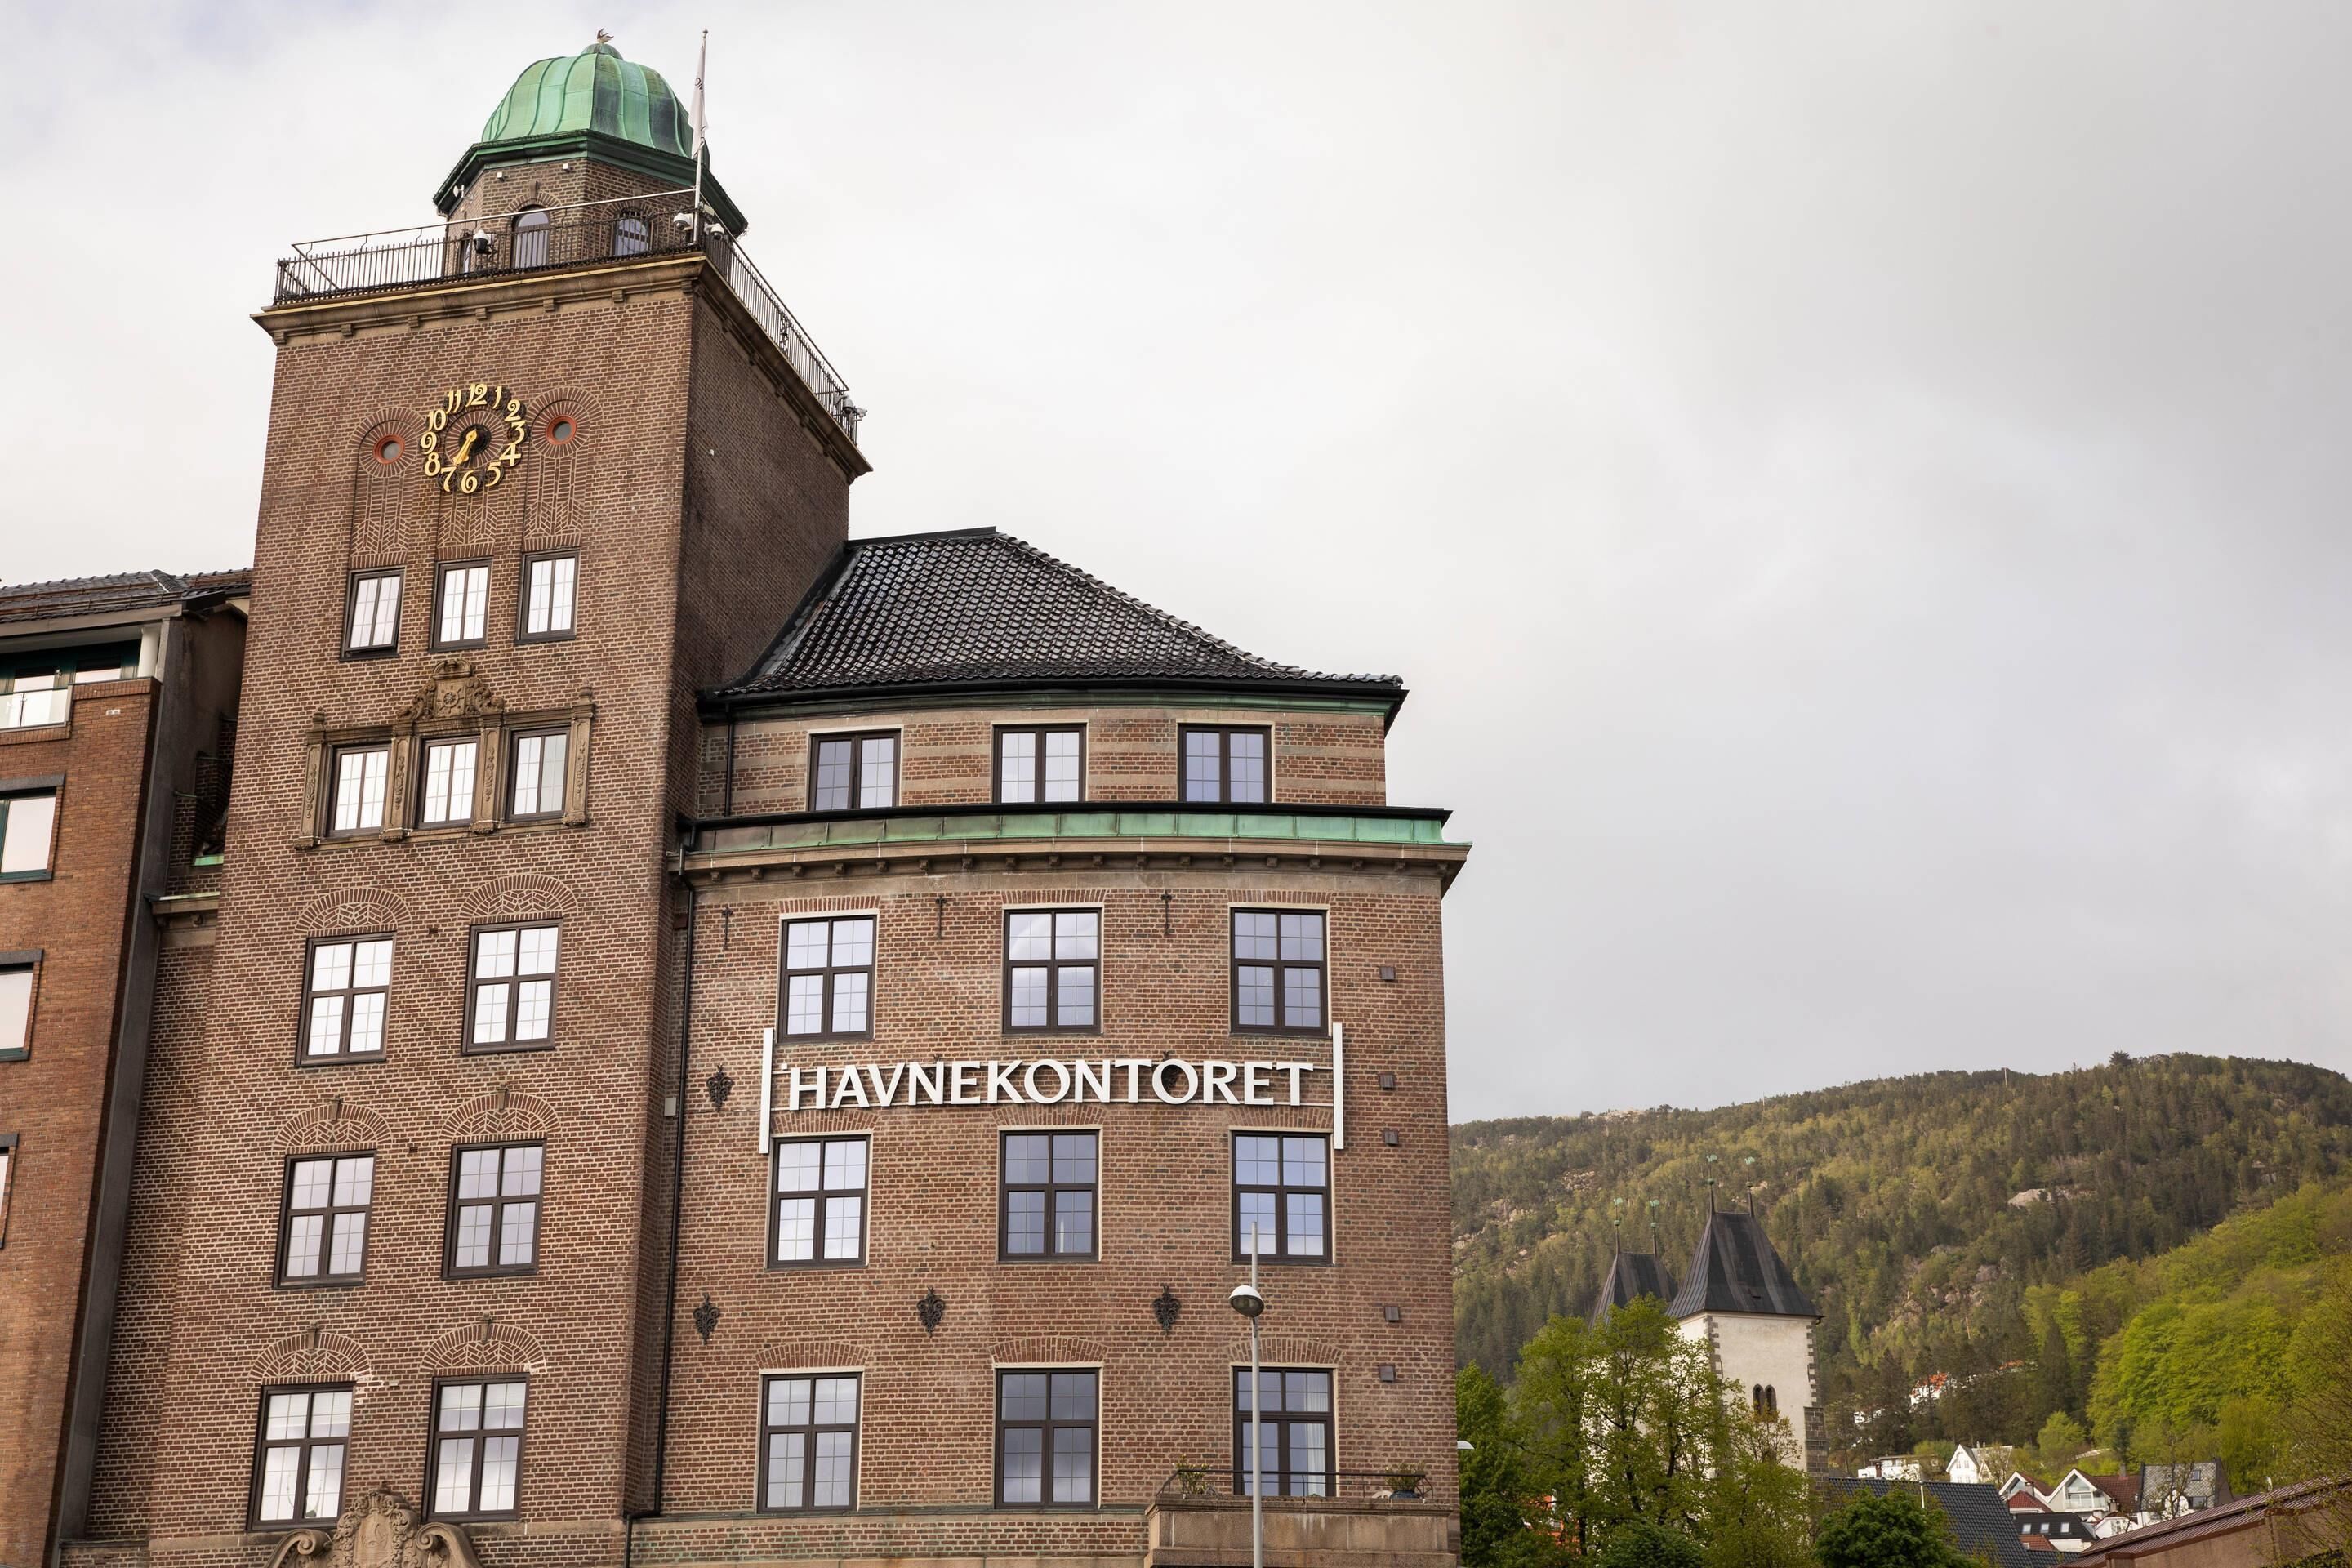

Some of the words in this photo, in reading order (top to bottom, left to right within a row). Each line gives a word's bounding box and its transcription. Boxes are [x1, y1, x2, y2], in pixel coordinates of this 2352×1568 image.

[446, 390, 461, 414] 11
[466, 384, 488, 407] 12
[492, 385, 501, 408] 1
[427, 409, 447, 431] 10
[505, 399, 521, 421] 2
[421, 432, 437, 454] 9
[508, 421, 526, 445] 3
[424, 452, 440, 476] 8
[499, 443, 521, 466] 4
[441, 466, 457, 492] 7
[461, 470, 477, 493] 6
[486, 461, 501, 486] 5
[789, 1058, 1314, 1111] HAVNEKONTORET
